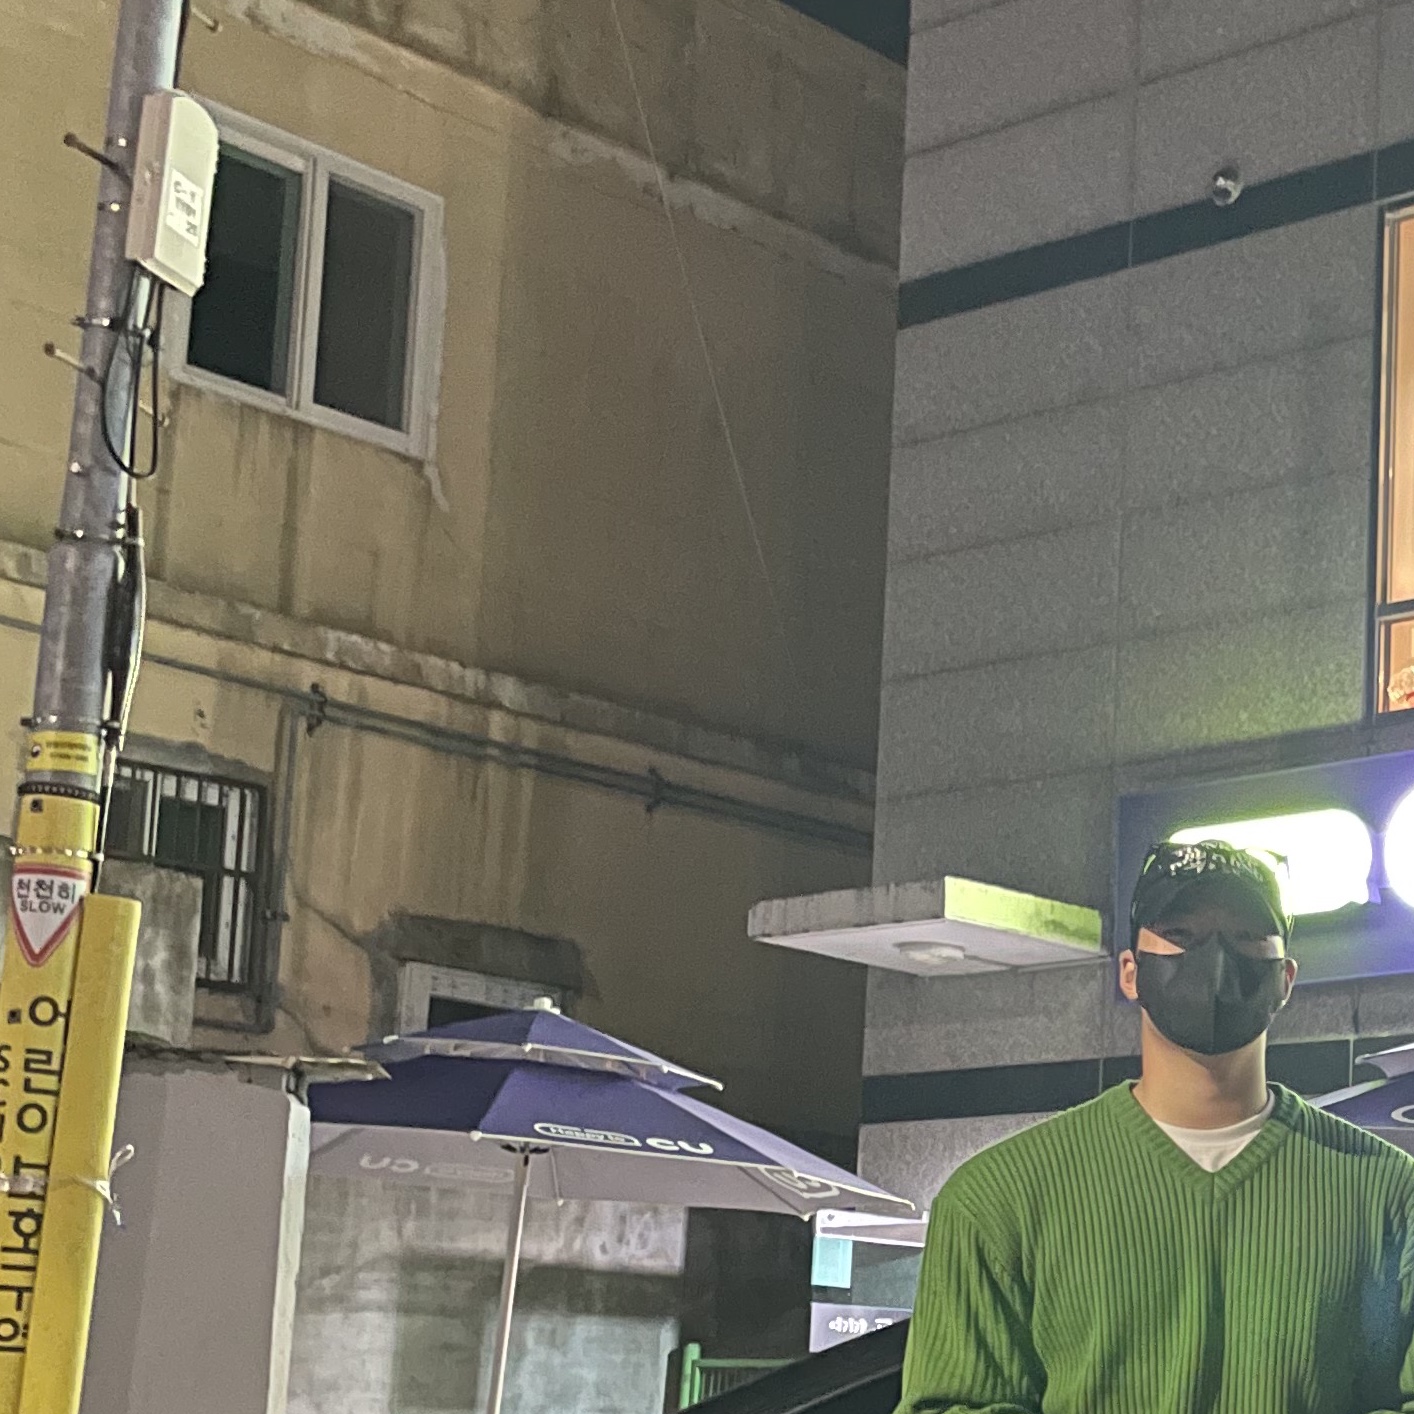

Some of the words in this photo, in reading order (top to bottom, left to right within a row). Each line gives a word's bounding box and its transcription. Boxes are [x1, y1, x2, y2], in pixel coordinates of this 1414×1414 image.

[16, 878, 77, 905] 천천히
[20, 899, 67, 915] SLOW
[646, 1138, 714, 1155] CU
